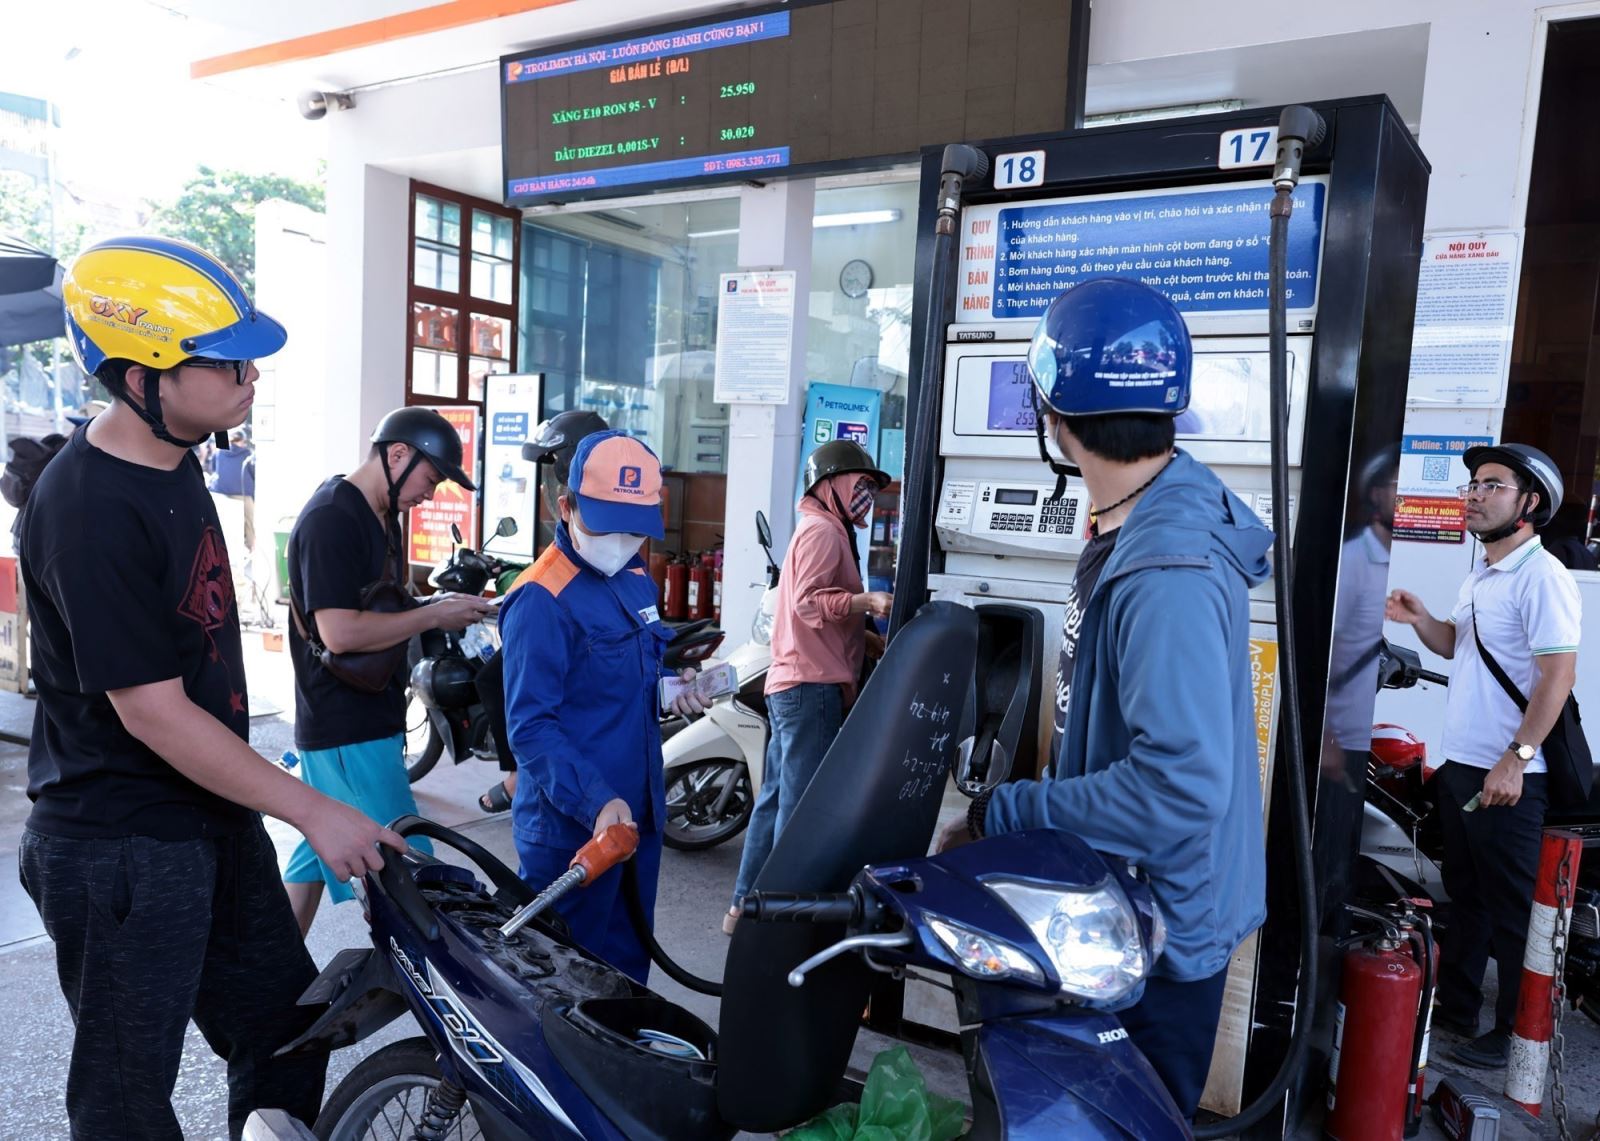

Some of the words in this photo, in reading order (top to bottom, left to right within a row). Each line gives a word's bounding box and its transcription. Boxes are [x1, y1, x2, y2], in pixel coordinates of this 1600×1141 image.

[588, 51, 606, 64] NỘI
[612, 42, 640, 59] LUÔN
[640, 38, 671, 54] ĐỒNG
[672, 33, 702, 48] HÀNH
[703, 27, 734, 42] CÙNG
[735, 23, 759, 37] BẠN
[610, 65, 626, 83] GIÁ
[628, 62, 647, 80] BÁN
[552, 109, 581, 124] XĂNG
[583, 107, 601, 120] E10
[602, 102, 628, 117] RON
[628, 101, 640, 112] 95
[648, 98, 657, 109] V
[720, 82, 755, 98] 25.950
[554, 145, 576, 162] DẦU
[577, 143, 615, 159] DIEZEL
[720, 126, 755, 141] 30.020
[1230, 131, 1271, 163] 17
[1003, 156, 1036, 185] 18
[1002, 221, 1010, 230] 1.
[1011, 218, 1041, 231] Hướng
[1043, 215, 1059, 227] dẫn
[1061, 214, 1088, 226] khách
[1090, 212, 1112, 224] hàng
[1114, 211, 1131, 221] vào
[1133, 210, 1142, 222] vị
[1158, 207, 1182, 218] chào
[1185, 205, 1200, 216] hỏi
[1202, 204, 1214, 215] và
[1216, 203, 1234, 214] xác
[1236, 202, 1260, 214] nhận
[1292, 197, 1305, 209] ầu
[971, 220, 991, 236] QUY
[1010, 235, 1026, 245] của
[1027, 233, 1053, 244] khách
[1055, 232, 1080, 243] hàng.
[965, 244, 994, 261] TRÌNH
[1000, 252, 1008, 261] 2.
[1009, 250, 1026, 261] Mời
[1027, 249, 1053, 259] khách
[1055, 247, 1077, 259] hàng
[1078, 246, 1095, 256] xác
[1096, 245, 1119, 257] nhận
[1121, 243, 1141, 253] màn
[1143, 242, 1164, 253] hình
[1166, 240, 1181, 253] cột
[1183, 240, 1206, 250] bơm
[1208, 238, 1233, 250] đang
[1235, 236, 1245, 247] ở
[1245, 234, 1259, 247] số
[1468, 241, 1487, 251] QUY
[967, 268, 989, 286] BÁN
[999, 267, 1007, 277] 3.
[1008, 267, 1028, 277] Bơm
[1031, 265, 1052, 276] hàng
[1054, 264, 1079, 275] đúng,
[1081, 261, 1092, 272] đủ
[1094, 262, 1114, 271] theo
[1116, 261, 1133, 272] yêu
[1135, 258, 1152, 269] cầu
[1154, 258, 1172, 268] của
[1173, 257, 1202, 267] khách
[1205, 256, 1232, 267] hàng.
[998, 283, 1006, 292] 4.
[1007, 281, 1024, 292] Mời
[1025, 281, 1051, 291] khách
[1163, 274, 1179, 286] cột
[1181, 274, 1203, 284] bơm
[1206, 272, 1233, 282] trước
[1236, 271, 1251, 281] khi
[1254, 270, 1270, 280] tha
[962, 293, 990, 310] HÀNG
[997, 299, 1005, 308] 5.
[1006, 298, 1028, 308] Thực
[1030, 296, 1049, 308] hiện
[1217, 290, 1231, 299] ơn
[1233, 287, 1264, 298] khách
[90, 295, 148, 325] OXY
[140, 321, 174, 335] PAINT
[958, 331, 993, 339] TATSUNO
[825, 401, 870, 412] PETROLIMEX
[1411, 440, 1443, 450] Hotline:
[1446, 441, 1465, 451] 1900
[1258, 671, 1274, 730] 2026/PLX
